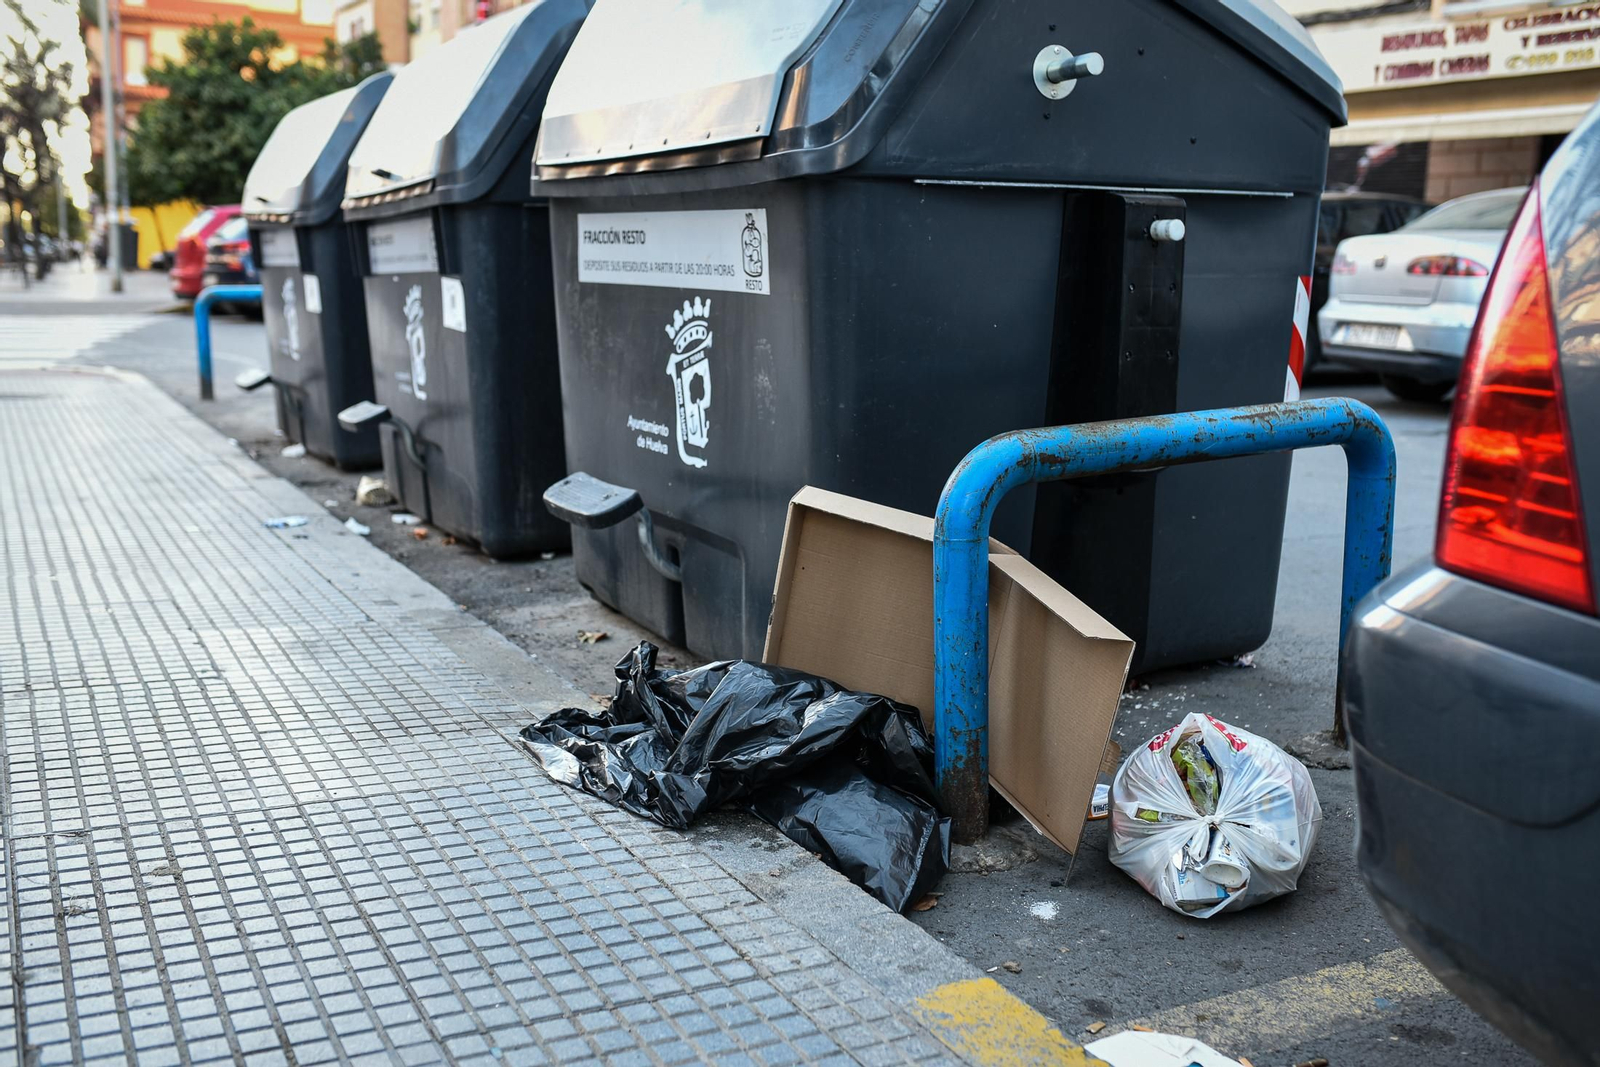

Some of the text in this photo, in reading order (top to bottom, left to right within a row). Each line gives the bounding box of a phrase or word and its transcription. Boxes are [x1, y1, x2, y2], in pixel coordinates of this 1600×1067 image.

[583, 227, 646, 244] FRACCIÓN RESTO
[610, 261, 621, 271] SUS
[622, 261, 648, 272] RESIDUOS
[654, 262, 673, 273] PARTIR
[675, 262, 682, 274] DE
[684, 263, 694, 275] LAS
[696, 263, 712, 275] 20:00
[714, 264, 735, 276] HORAS
[745, 280, 762, 291] RESTO
[627, 414, 669, 437] Ayuntamiento
[637, 435, 668, 455] de Huelva
